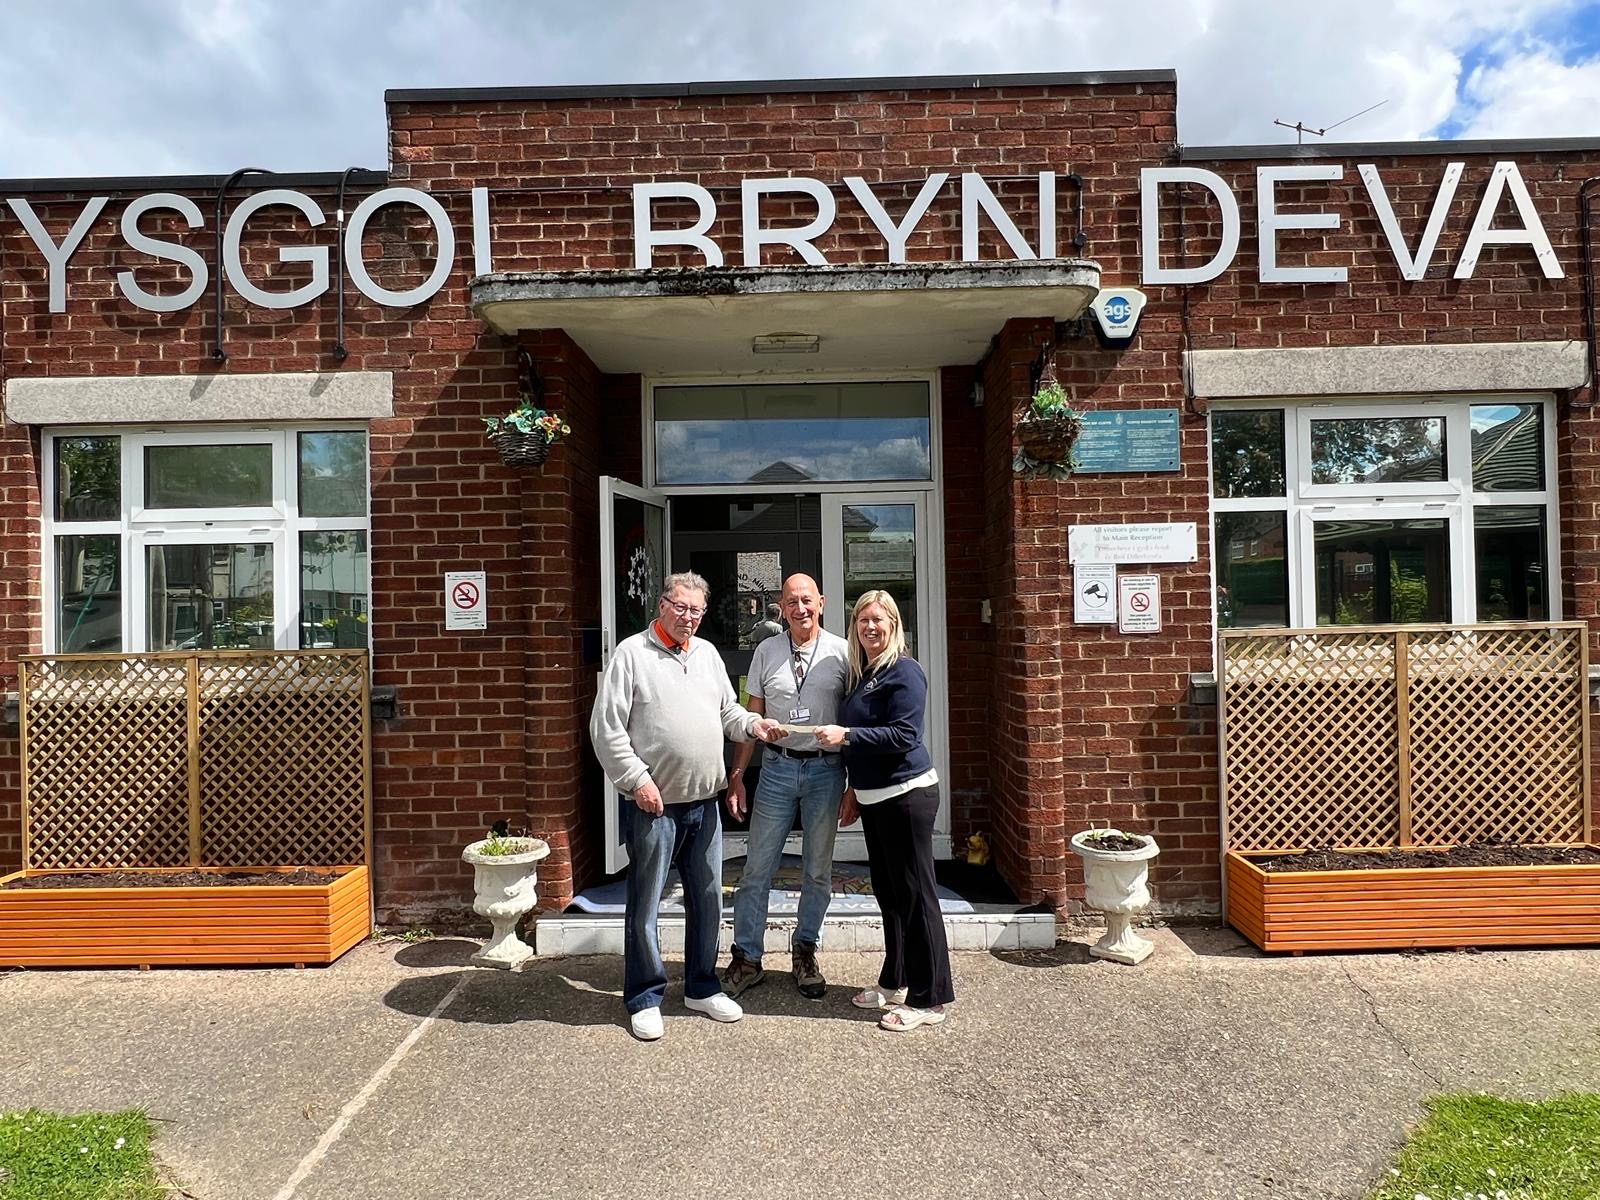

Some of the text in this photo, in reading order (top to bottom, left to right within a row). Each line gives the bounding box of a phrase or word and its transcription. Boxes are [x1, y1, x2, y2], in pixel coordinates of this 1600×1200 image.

[633, 171, 1056, 268] BRYN
[1140, 161, 1565, 285] DEVA
[1104, 304, 1132, 320] ags
[1129, 525, 1150, 534] please
[1151, 525, 1173, 533] report
[1130, 534, 1163, 542] Reception
[752, 577, 773, 601] MINDS
